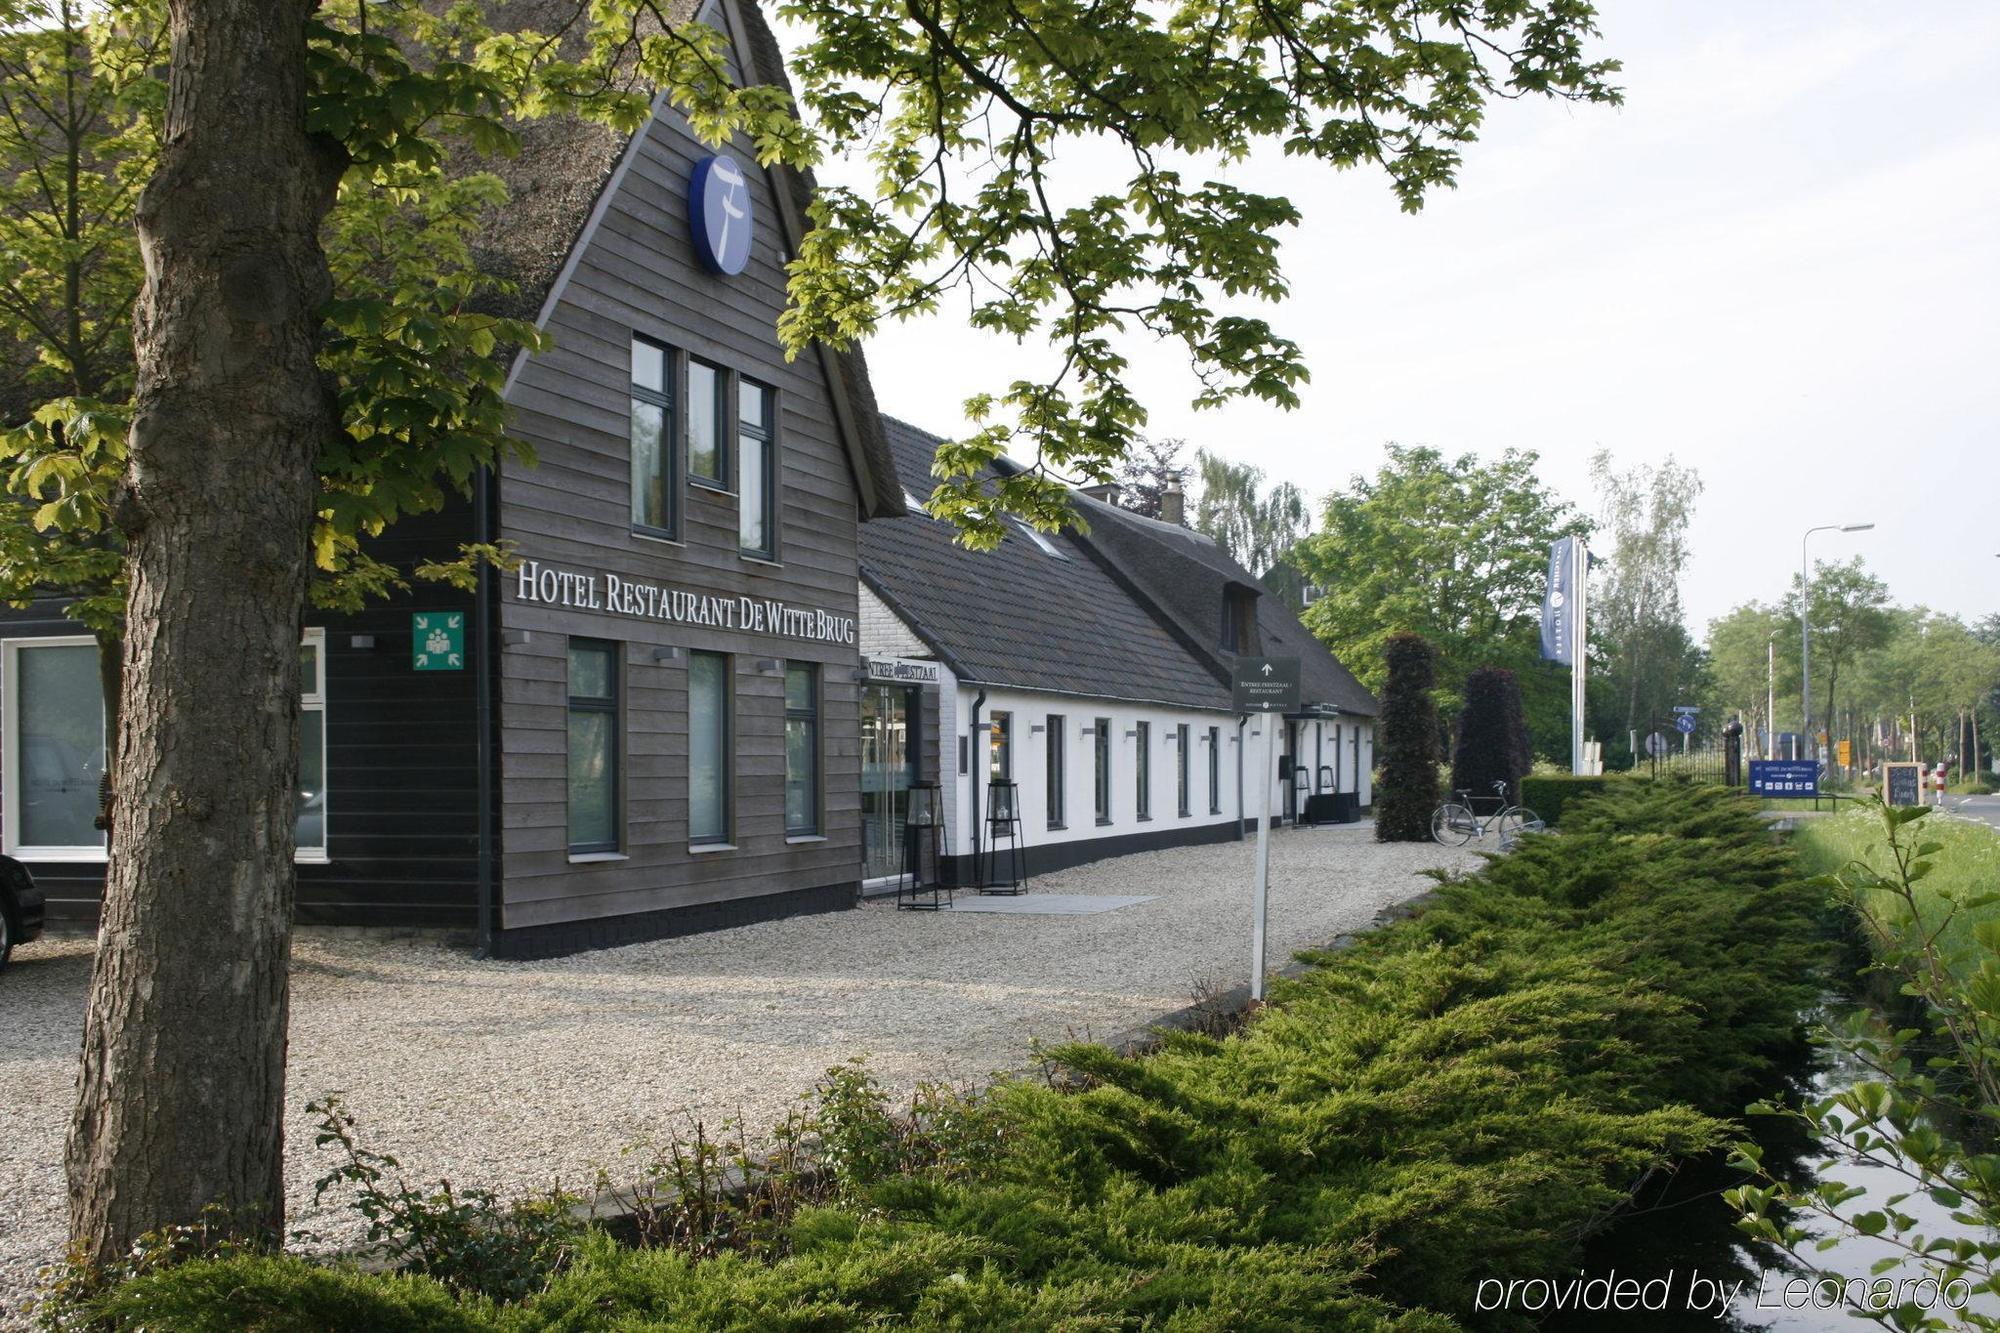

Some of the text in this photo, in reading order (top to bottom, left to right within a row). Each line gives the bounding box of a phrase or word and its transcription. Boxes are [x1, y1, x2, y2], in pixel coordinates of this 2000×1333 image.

[517, 561, 599, 609] HOTEL
[606, 574, 735, 628] RESTAURANT
[867, 661, 894, 678] NTREE
